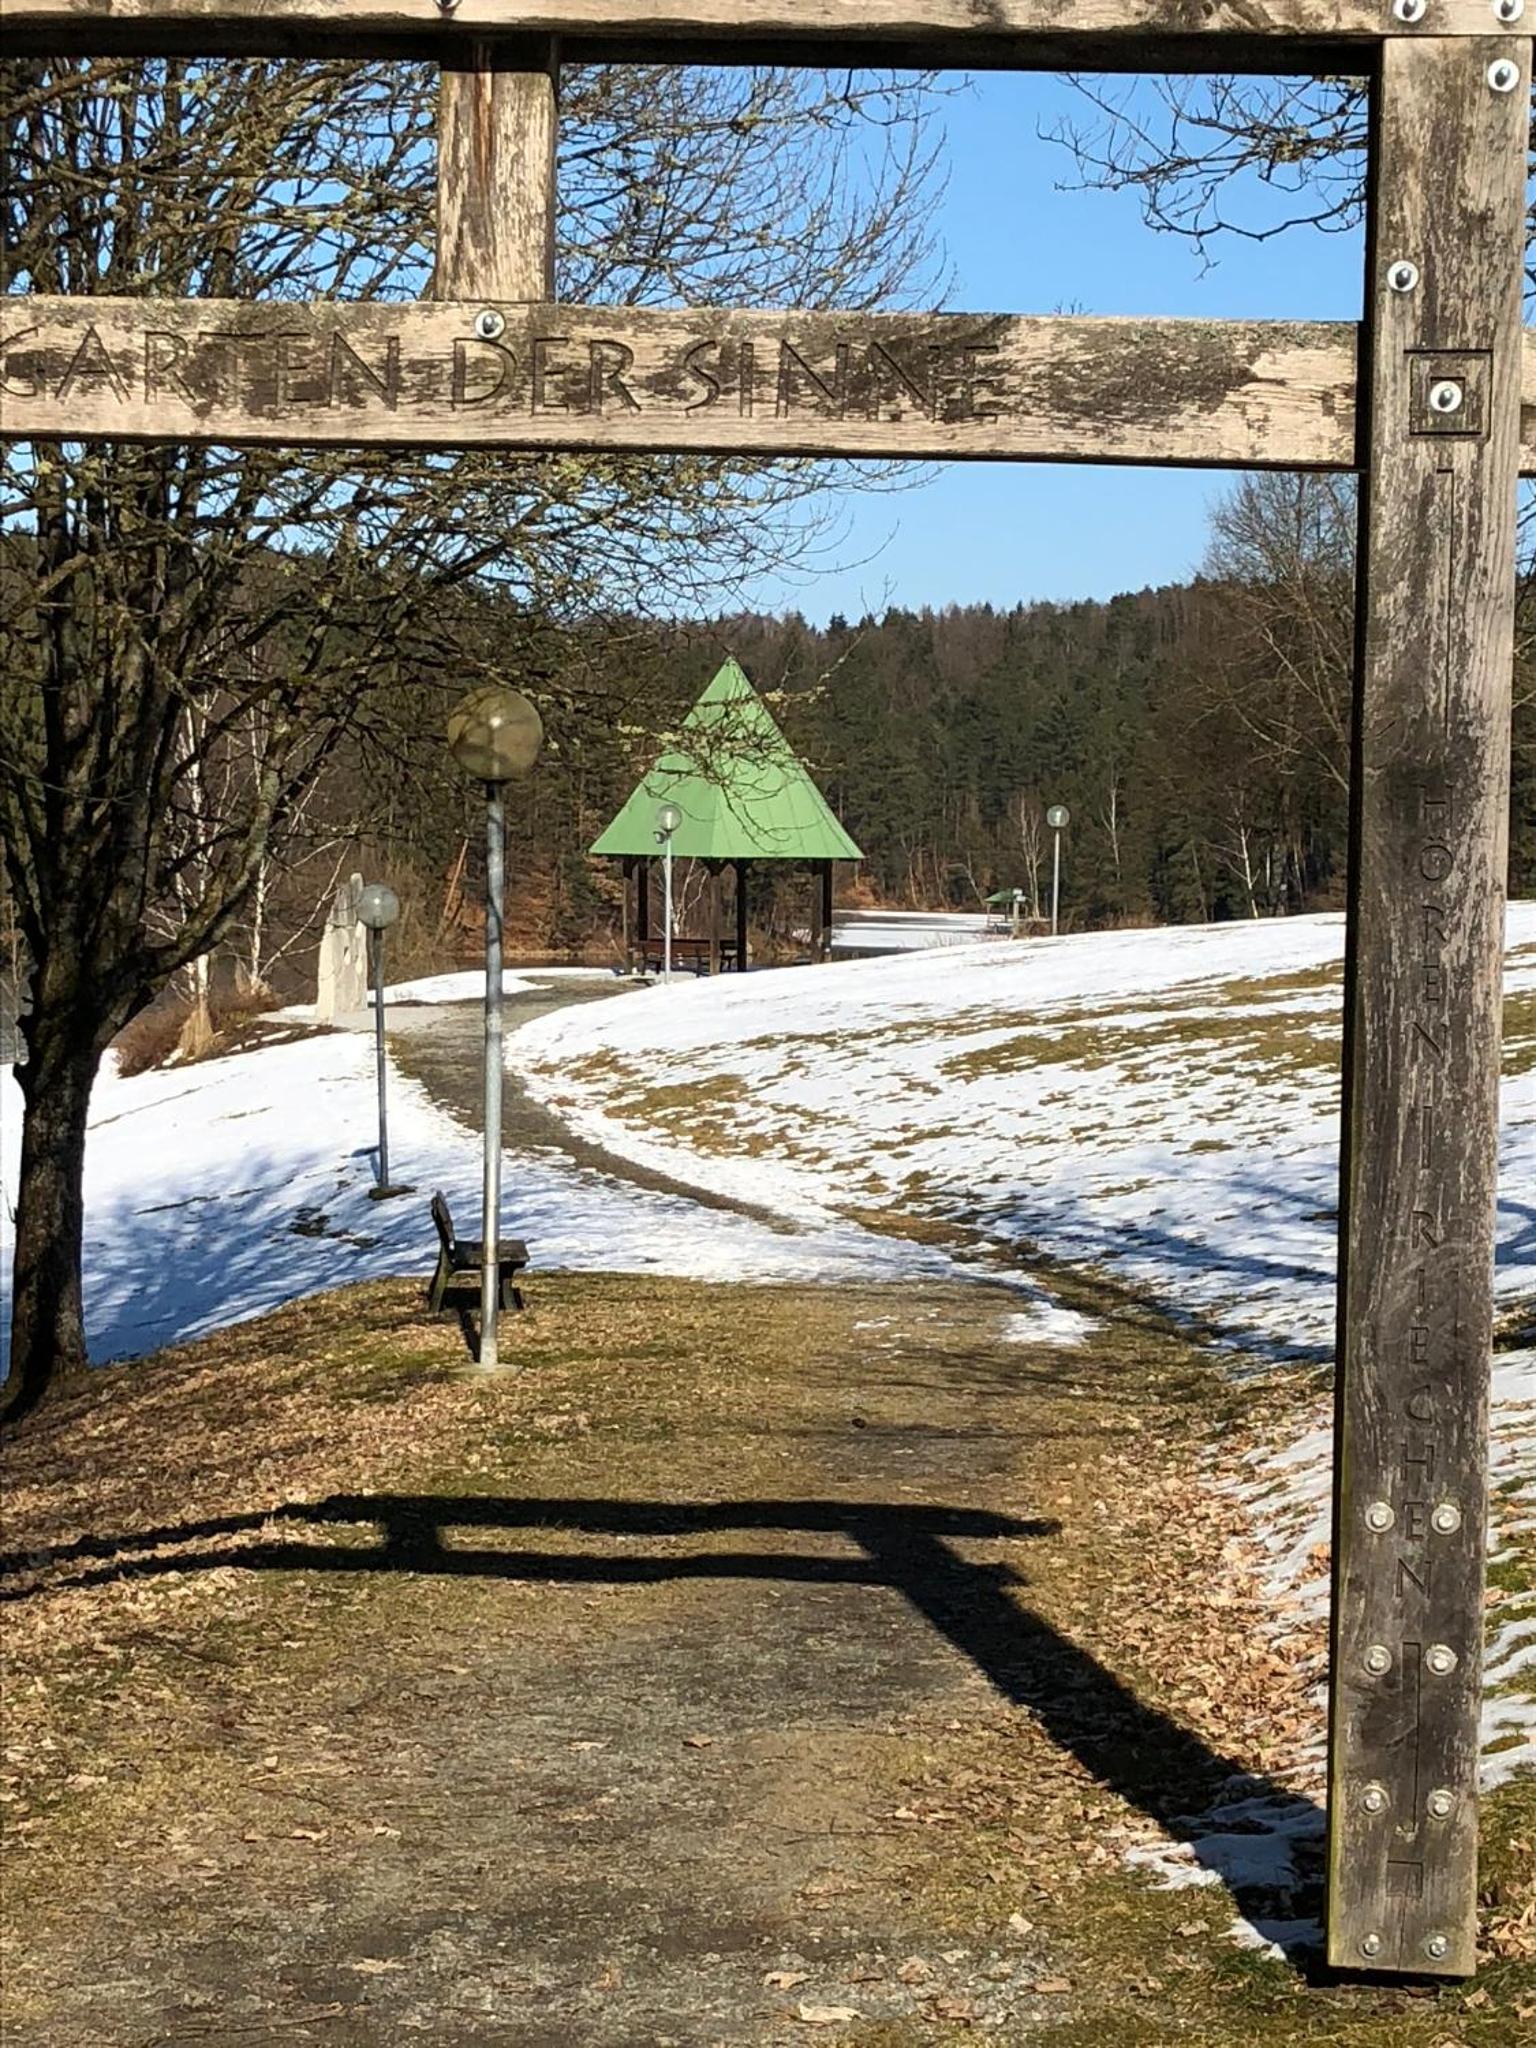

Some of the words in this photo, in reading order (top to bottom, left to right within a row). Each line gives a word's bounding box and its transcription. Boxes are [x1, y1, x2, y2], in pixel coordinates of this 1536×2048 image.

[0, 325, 400, 412] GARTEN
[451, 336, 643, 415] DER
[683, 339, 999, 423] SINNE
